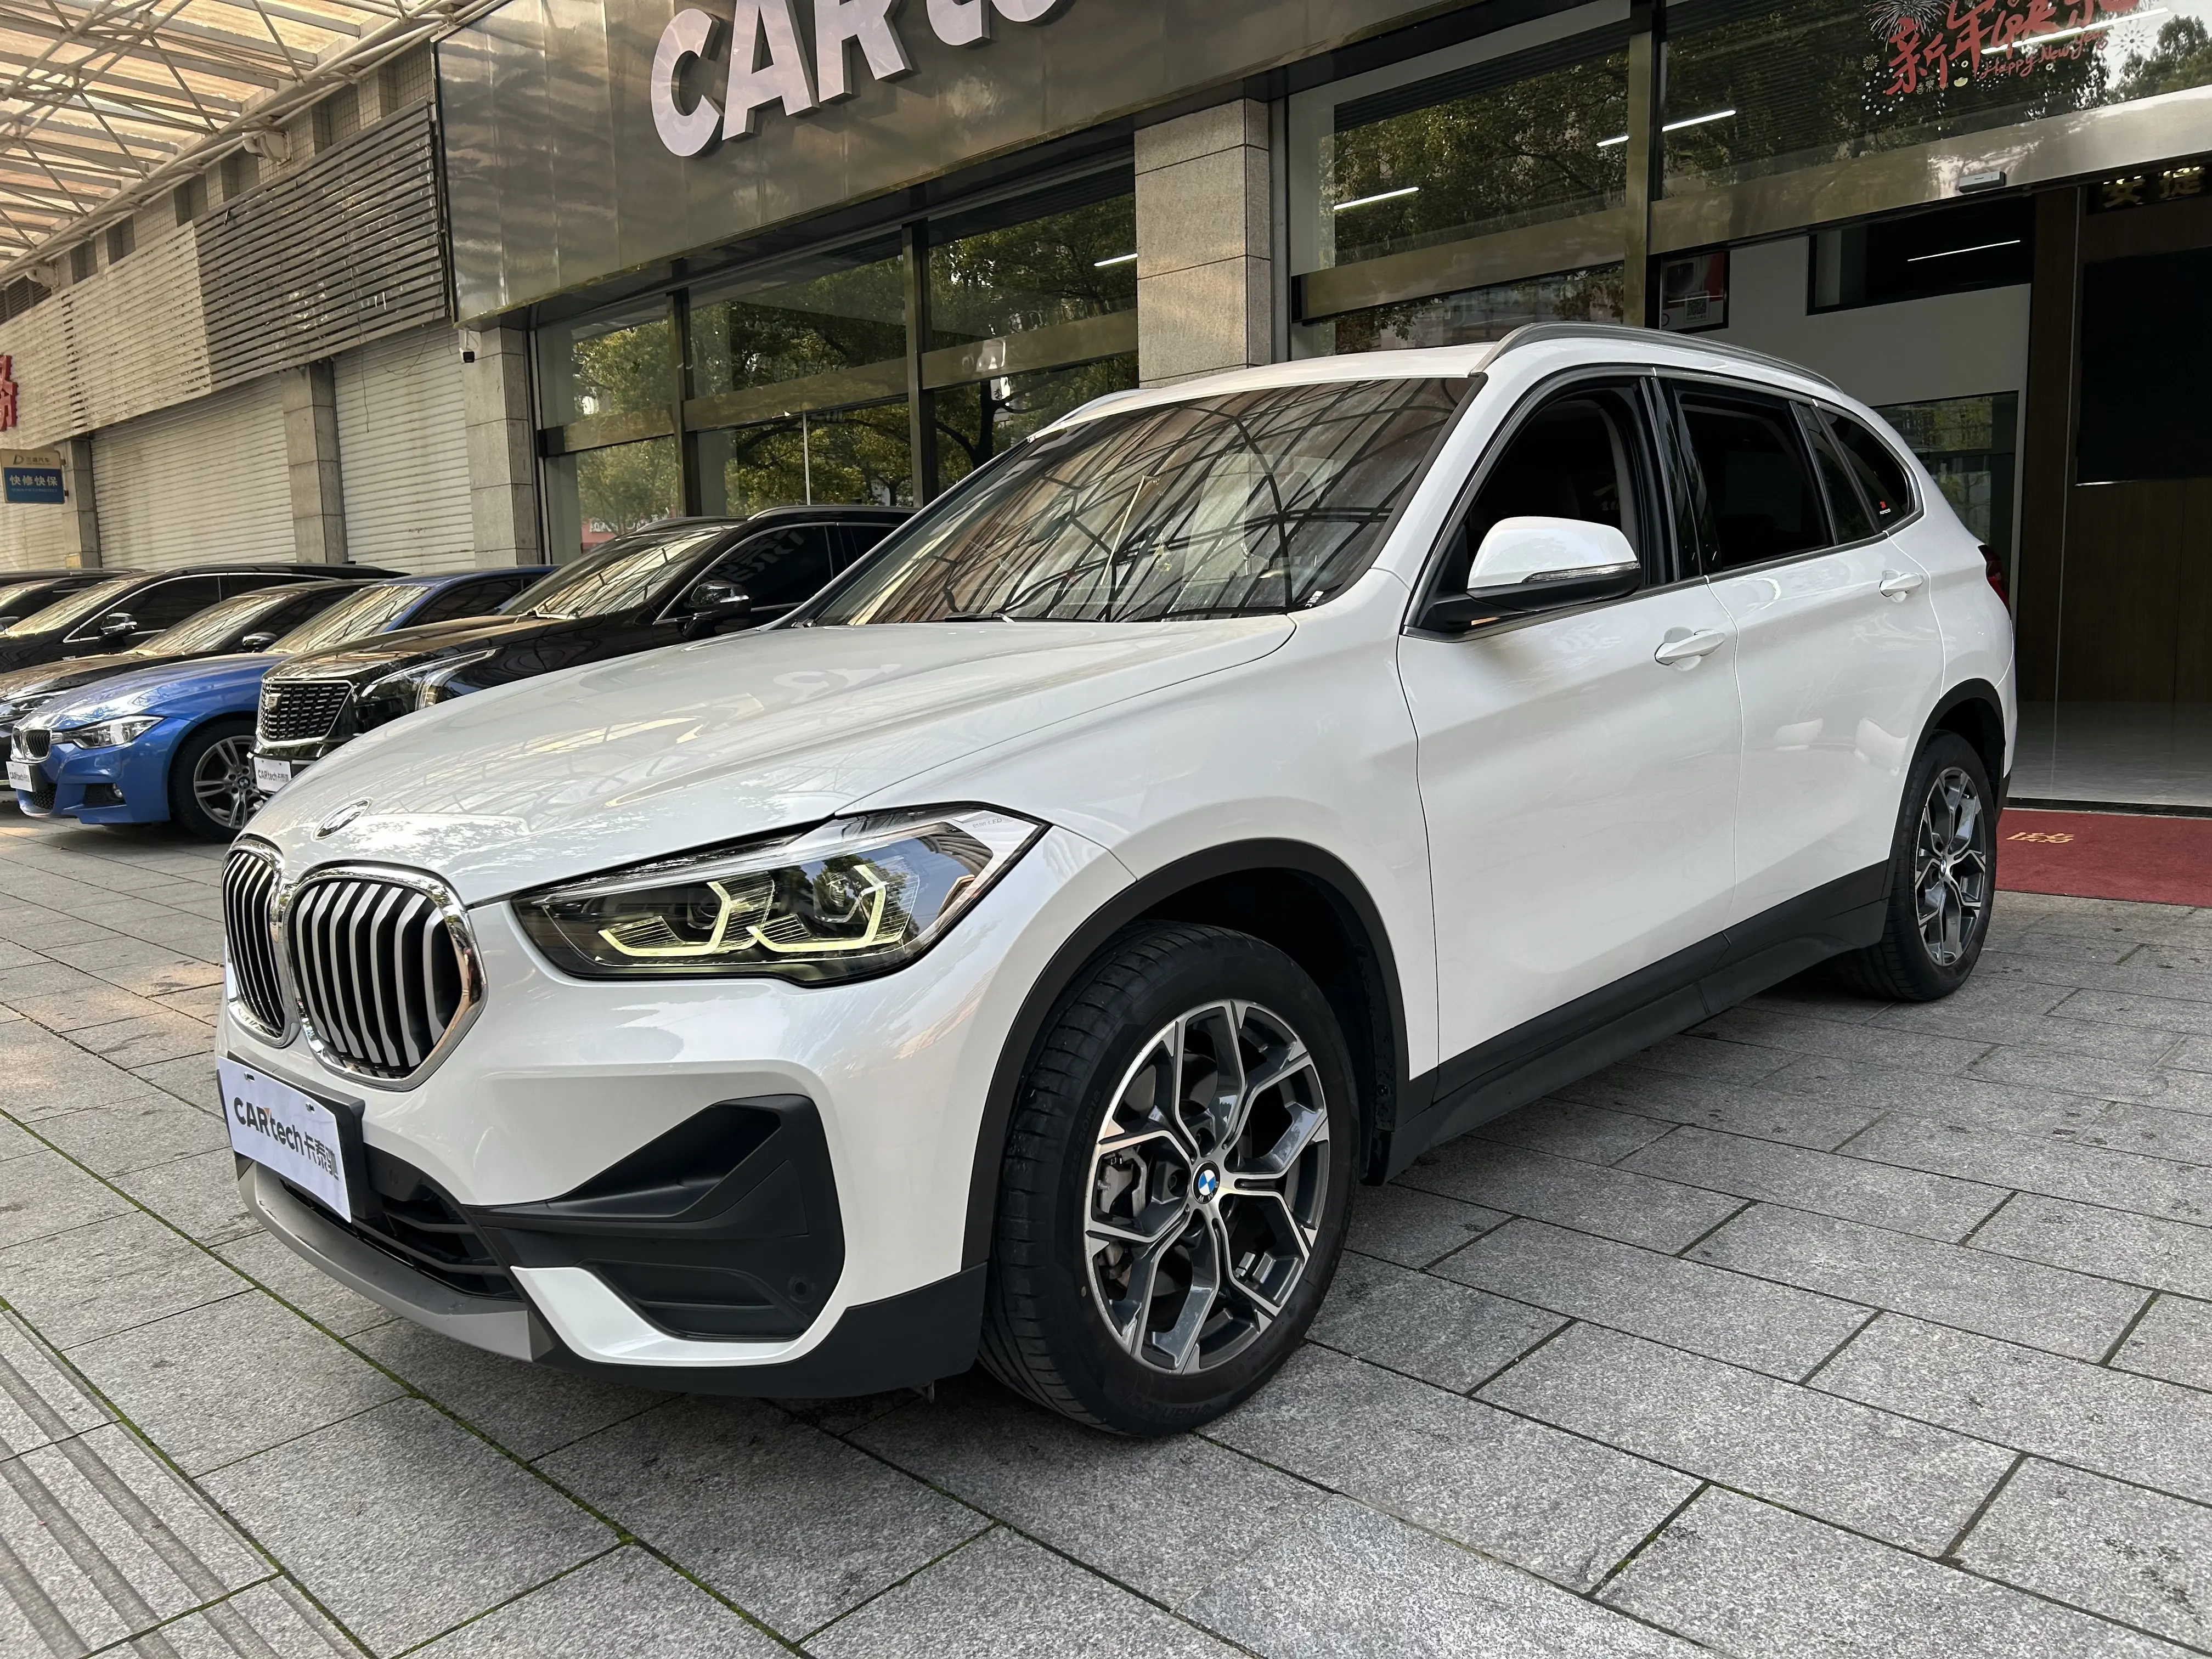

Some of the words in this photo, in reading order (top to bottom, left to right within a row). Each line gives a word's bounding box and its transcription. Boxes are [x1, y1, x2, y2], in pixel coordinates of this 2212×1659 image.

[651, 0, 1060, 157] CAR
[1979, 55, 2040, 79] Happy
[2038, 44, 2072, 63] New
[9, 475, 58, 487] 快修快保
[234, 1097, 304, 1156] CARtech
